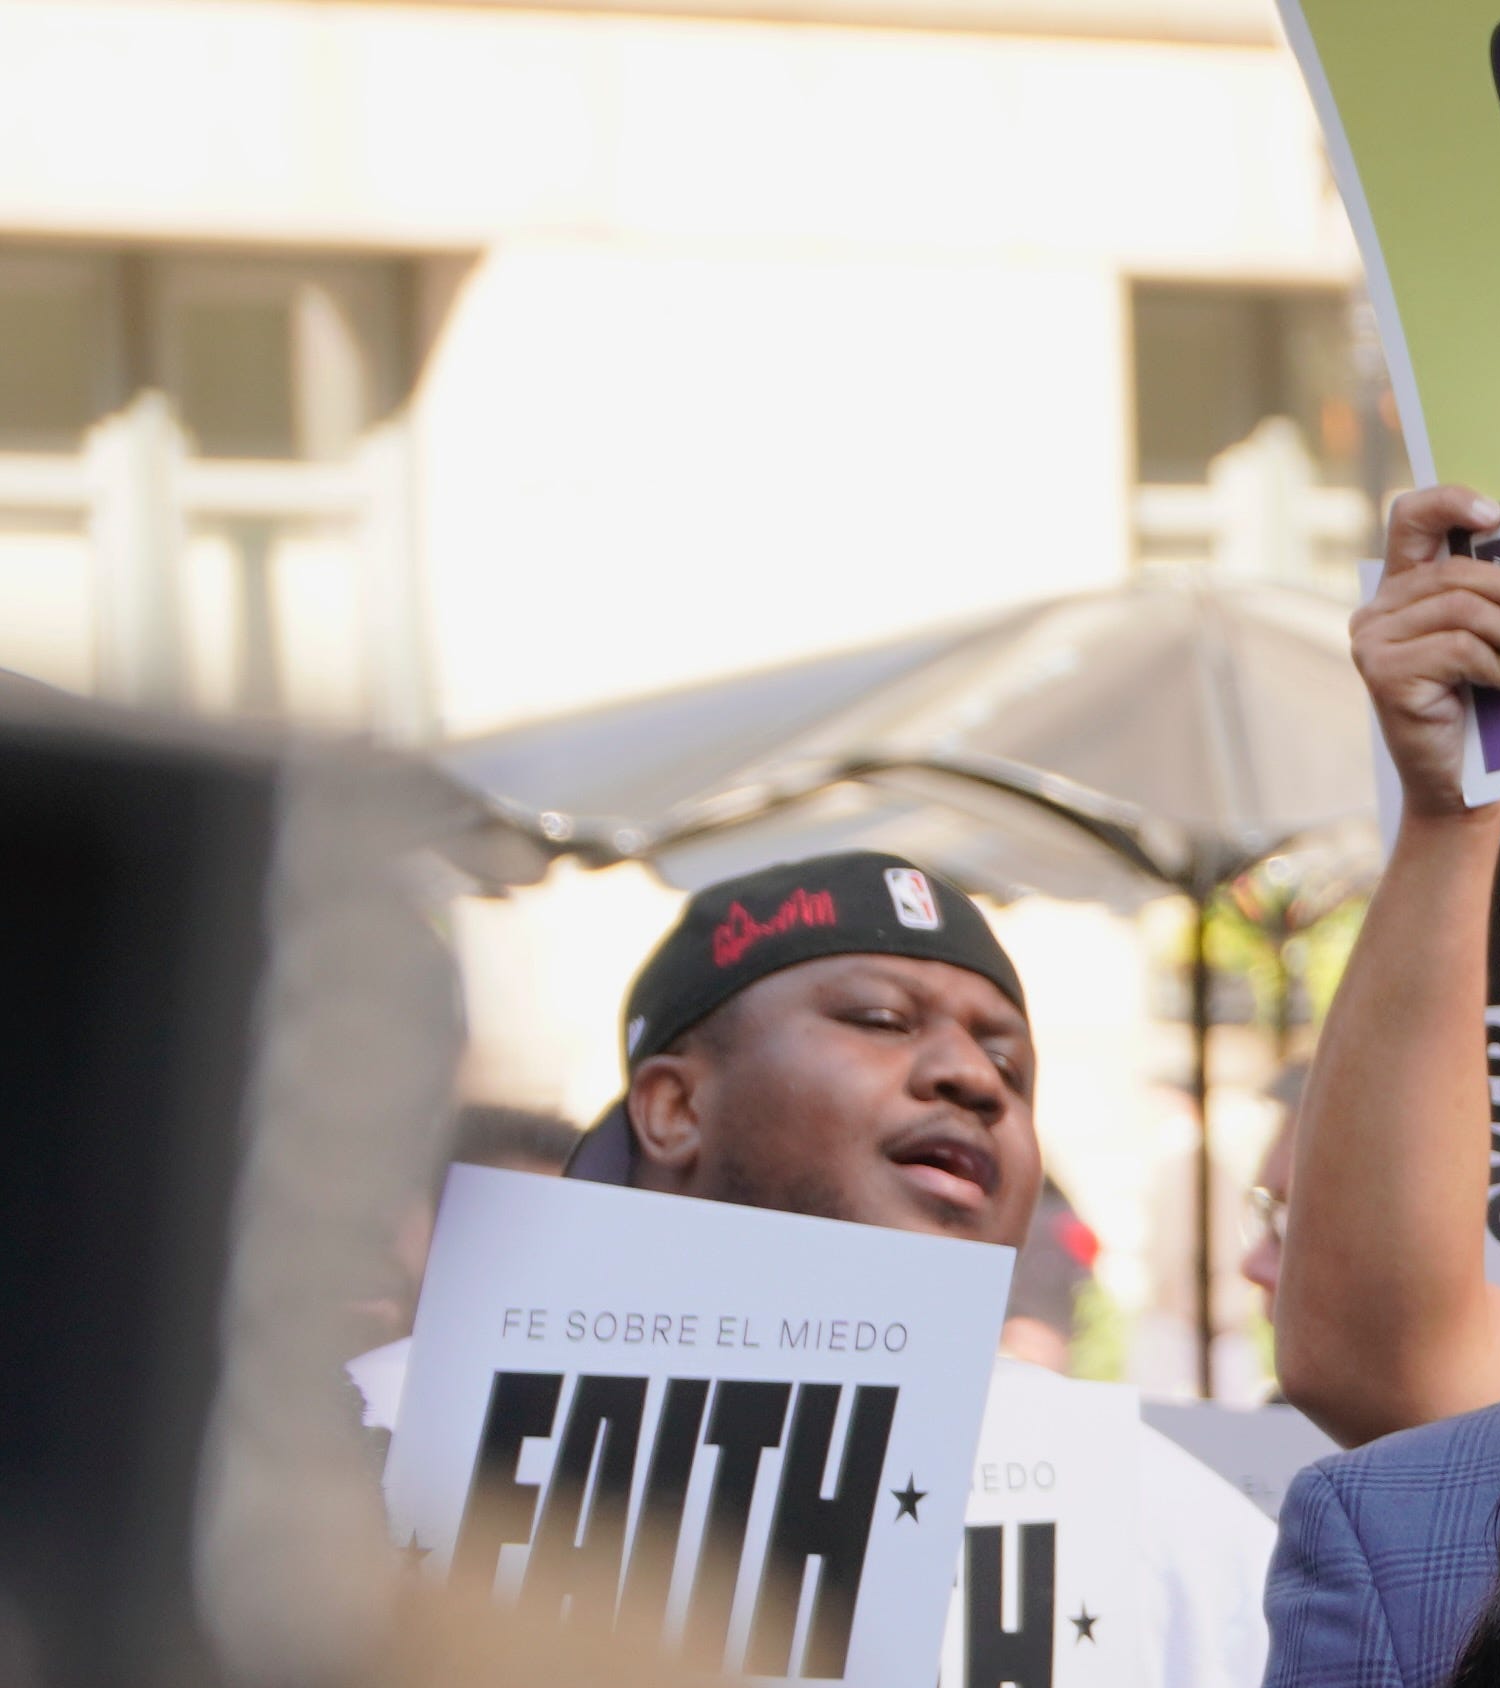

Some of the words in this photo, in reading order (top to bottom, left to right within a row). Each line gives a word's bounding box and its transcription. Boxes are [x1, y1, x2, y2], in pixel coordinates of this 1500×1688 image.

[501, 1308, 548, 1344] FE
[565, 1308, 700, 1349] SOBRE
[719, 1314, 764, 1350] EL
[778, 1319, 912, 1355] MIEDO
